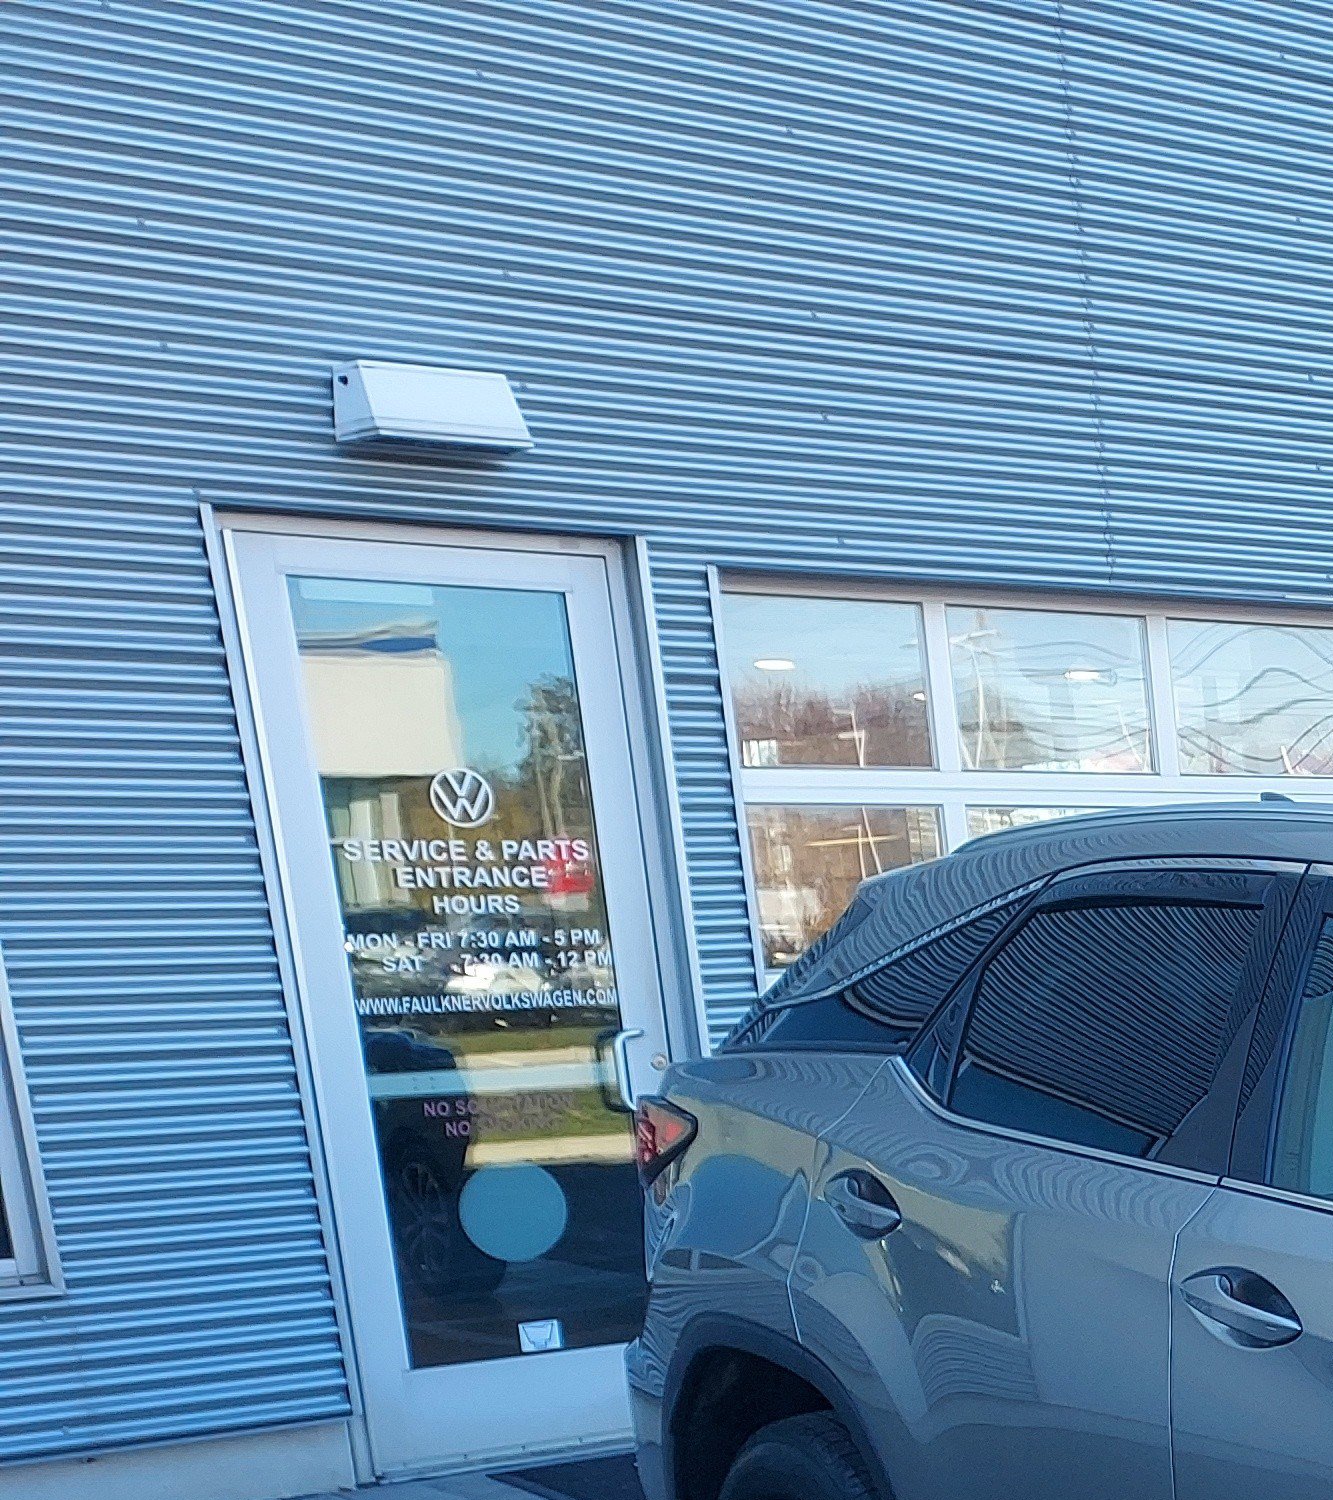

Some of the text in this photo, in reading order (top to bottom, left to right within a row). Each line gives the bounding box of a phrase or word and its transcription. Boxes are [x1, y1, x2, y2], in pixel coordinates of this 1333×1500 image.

[430, 768, 494, 828] VW
[342, 838, 590, 862] SERVICE & PARTS
[395, 866, 549, 889] ENTRANCE
[433, 894, 521, 914] HOURS
[347, 932, 398, 950] MON
[417, 932, 451, 949] FRI
[458, 930, 499, 949] 7:30
[504, 930, 537, 948] AM
[554, 930, 565, 947] 5
[571, 929, 600, 946] PM
[383, 956, 425, 973] SAT
[508, 952, 539, 968] AM
[557, 951, 579, 968] 12
[585, 950, 612, 967] PM
[355, 988, 617, 1015] WWW.FAULKNERVOLKSWAGEN.COM
[424, 1101, 450, 1117] NO
[445, 1121, 470, 1137] NO
